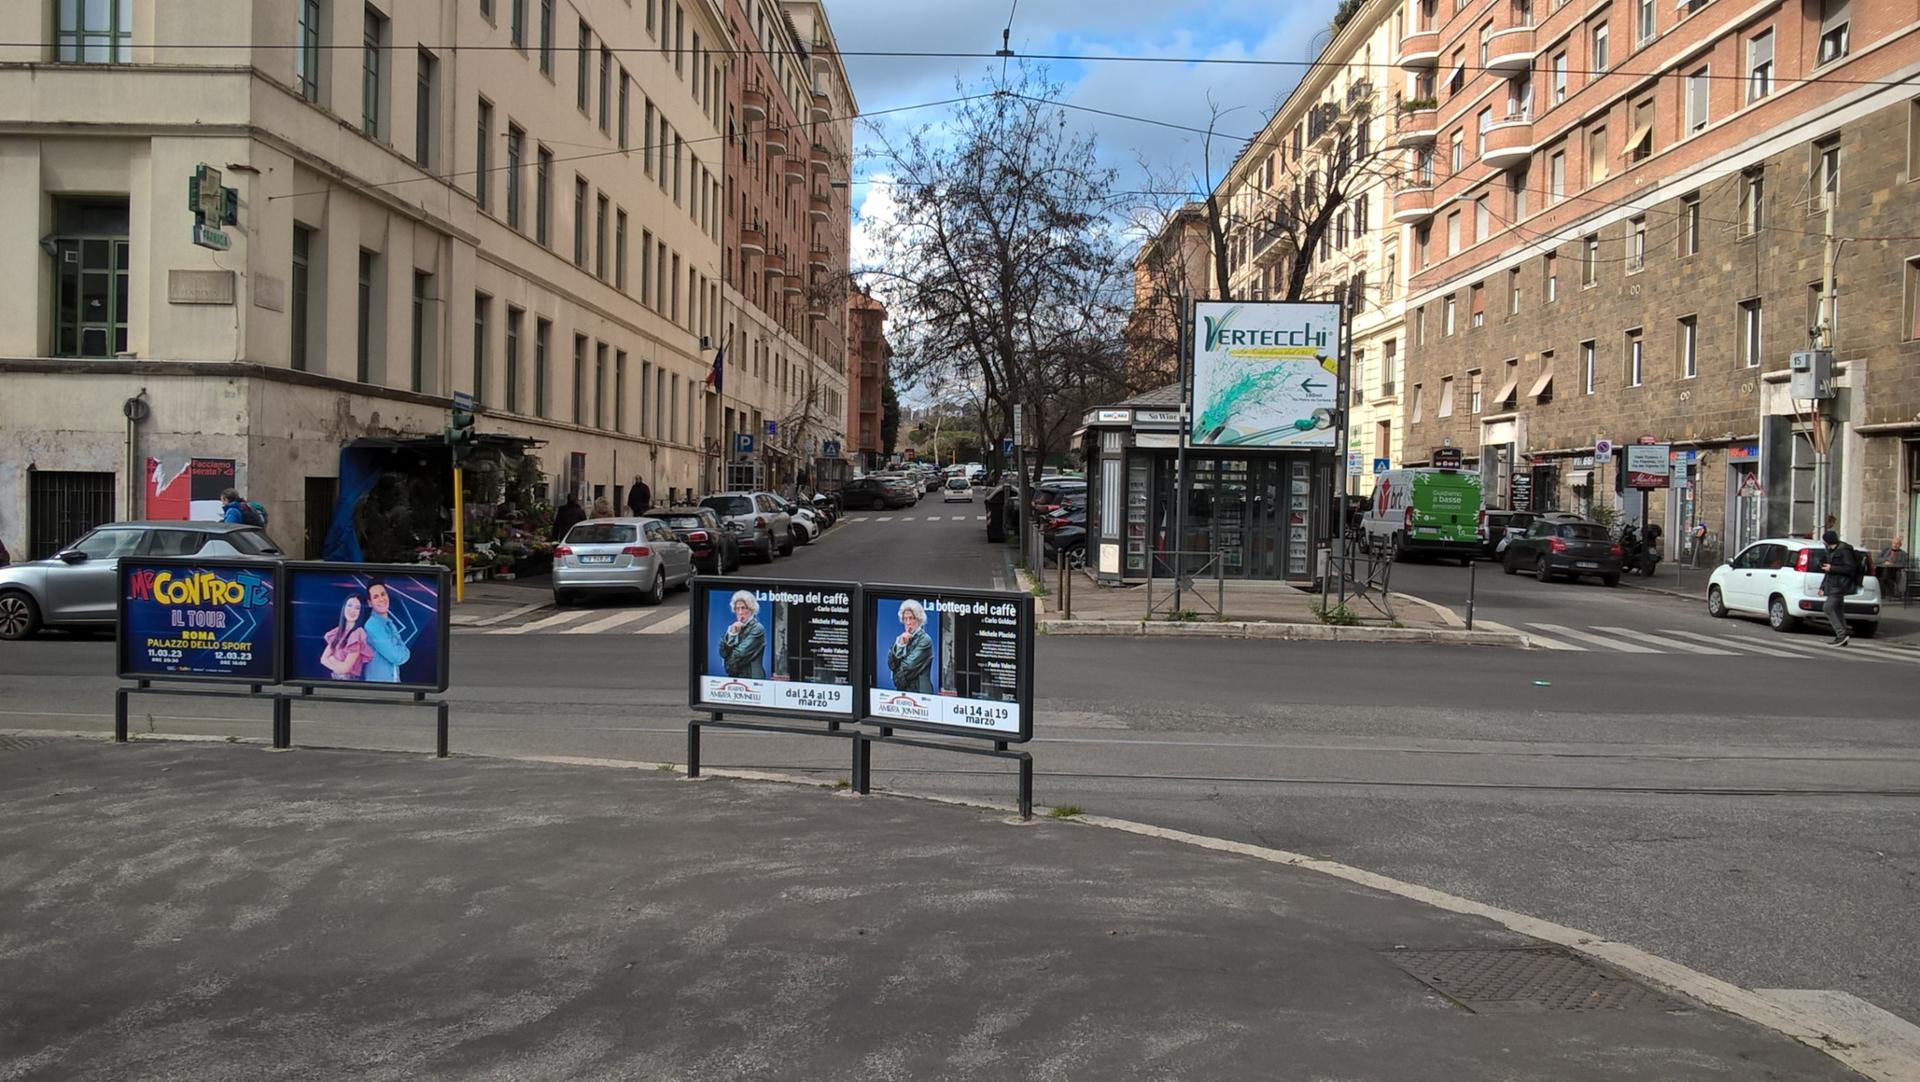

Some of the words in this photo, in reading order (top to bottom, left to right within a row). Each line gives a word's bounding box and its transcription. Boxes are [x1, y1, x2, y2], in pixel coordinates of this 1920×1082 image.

[1794, 357, 1801, 365] 15
[192, 459, 230, 467] Facciamo
[756, 590, 767, 601] La
[769, 590, 804, 605] bottega
[806, 592, 821, 603] del
[823, 592, 849, 605] caffè
[923, 599, 934, 611] La
[936, 599, 971, 616] bottega
[973, 602, 988, 614] del
[990, 603, 1016, 617] caffè
[171, 610, 185, 627] IL
[187, 610, 226, 628] TOUR
[182, 631, 216, 640] ROMA
[147, 639, 188, 648] PALAZZO
[191, 640, 220, 649] DELLO
[222, 642, 252, 651] SPORT
[148, 649, 183, 658] 11.03.23
[215, 651, 252, 660] 12.03.23
[786, 688, 800, 698] dal
[802, 689, 815, 699] 14
[817, 691, 825, 699] al
[829, 691, 840, 701] 19
[798, 699, 827, 708] marzo
[953, 704, 967, 714] dal
[970, 706, 982, 716] 14
[984, 707, 993, 717] al
[995, 708, 1008, 719] 19
[965, 715, 995, 726] marzo
